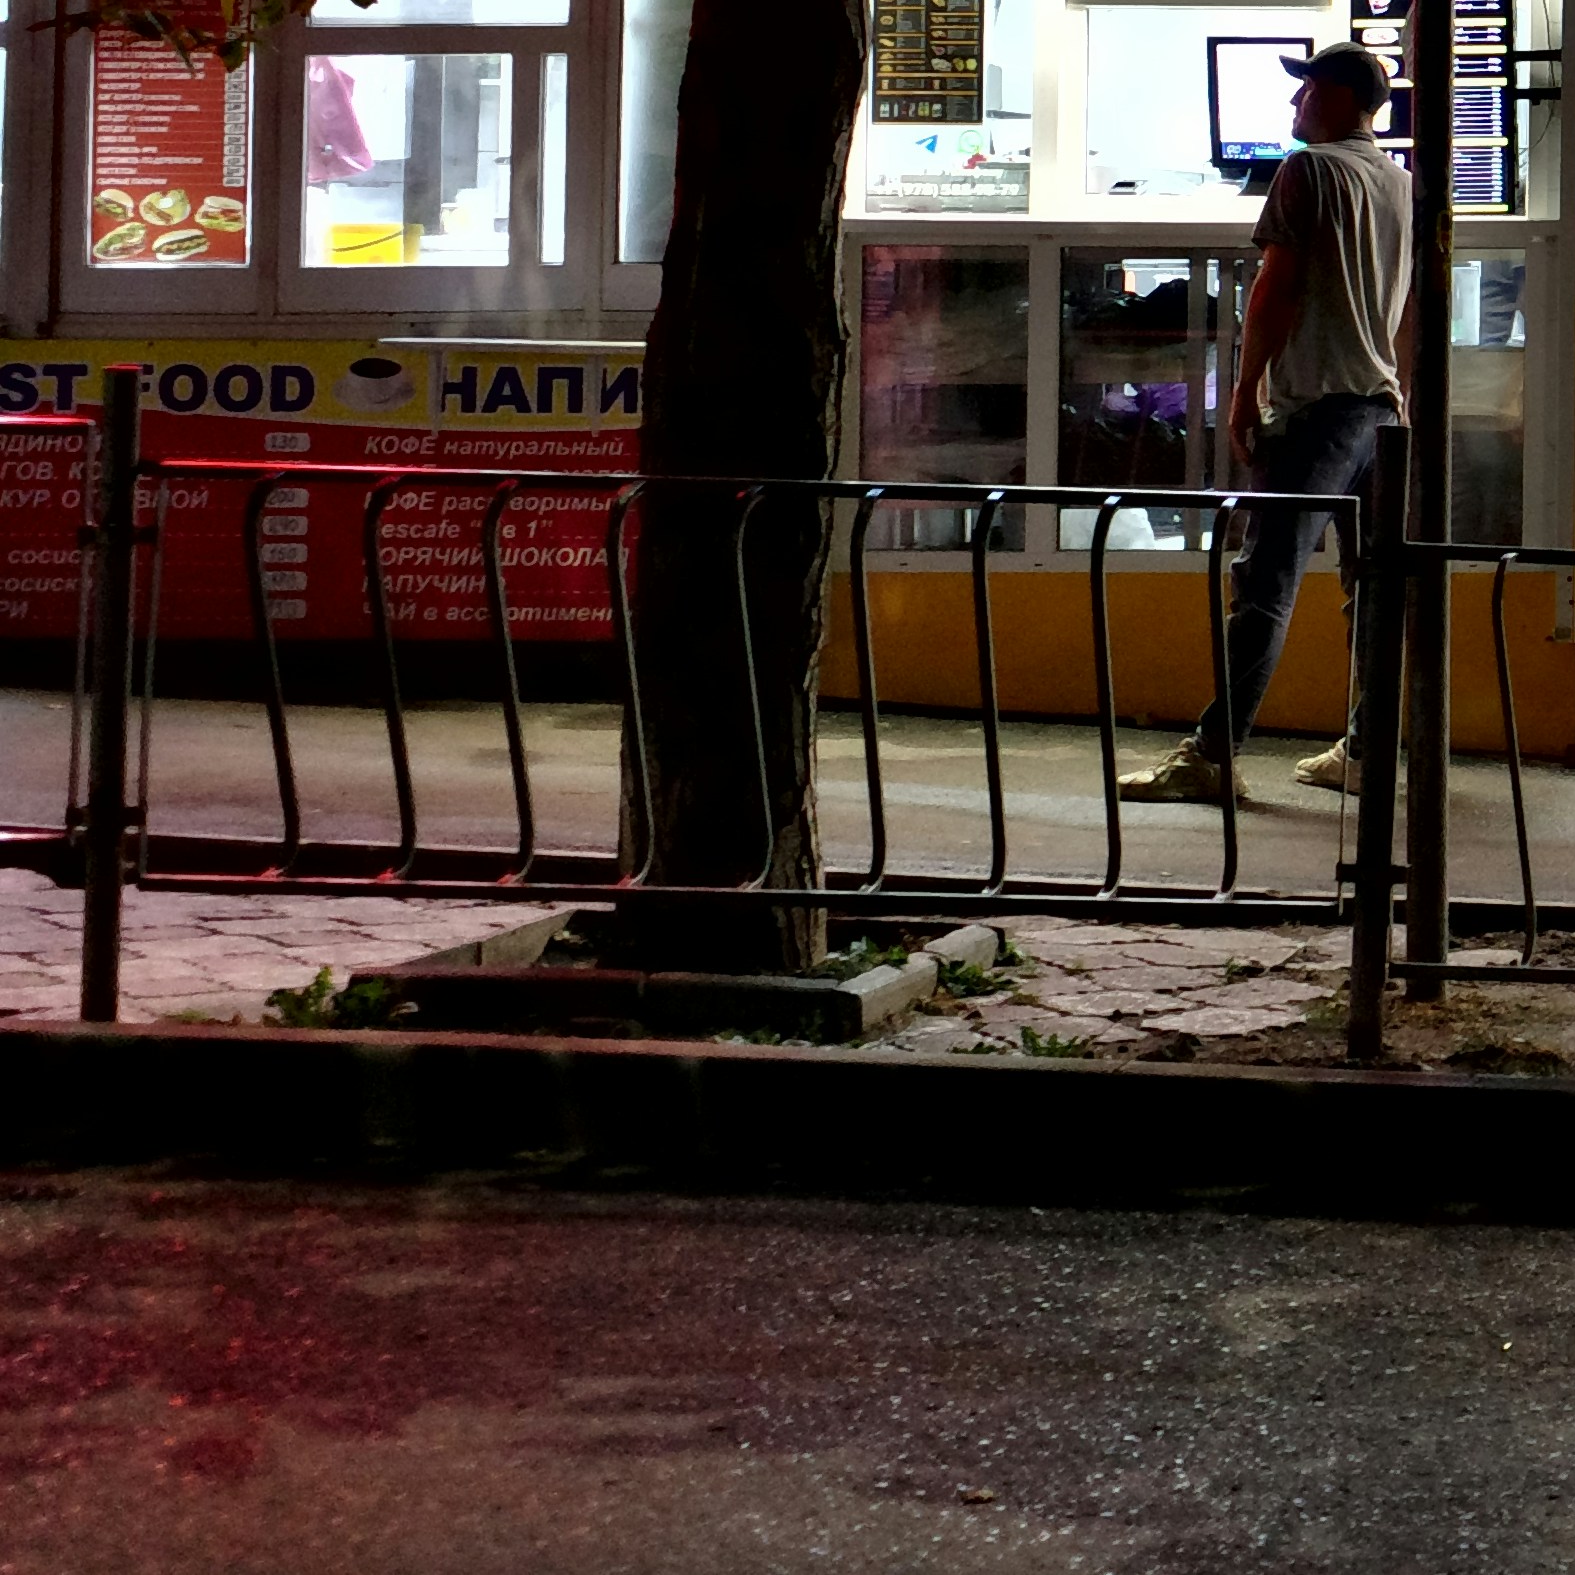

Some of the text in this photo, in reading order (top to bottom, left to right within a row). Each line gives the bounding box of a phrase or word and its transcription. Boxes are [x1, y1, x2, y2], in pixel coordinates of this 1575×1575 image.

[141, 363, 315, 413] OOD
[364, 435, 624, 460] КОФЕ натуральный
[380, 522, 461, 539] escafe
[364, 542, 485, 567] ОРЯЧИЙ
